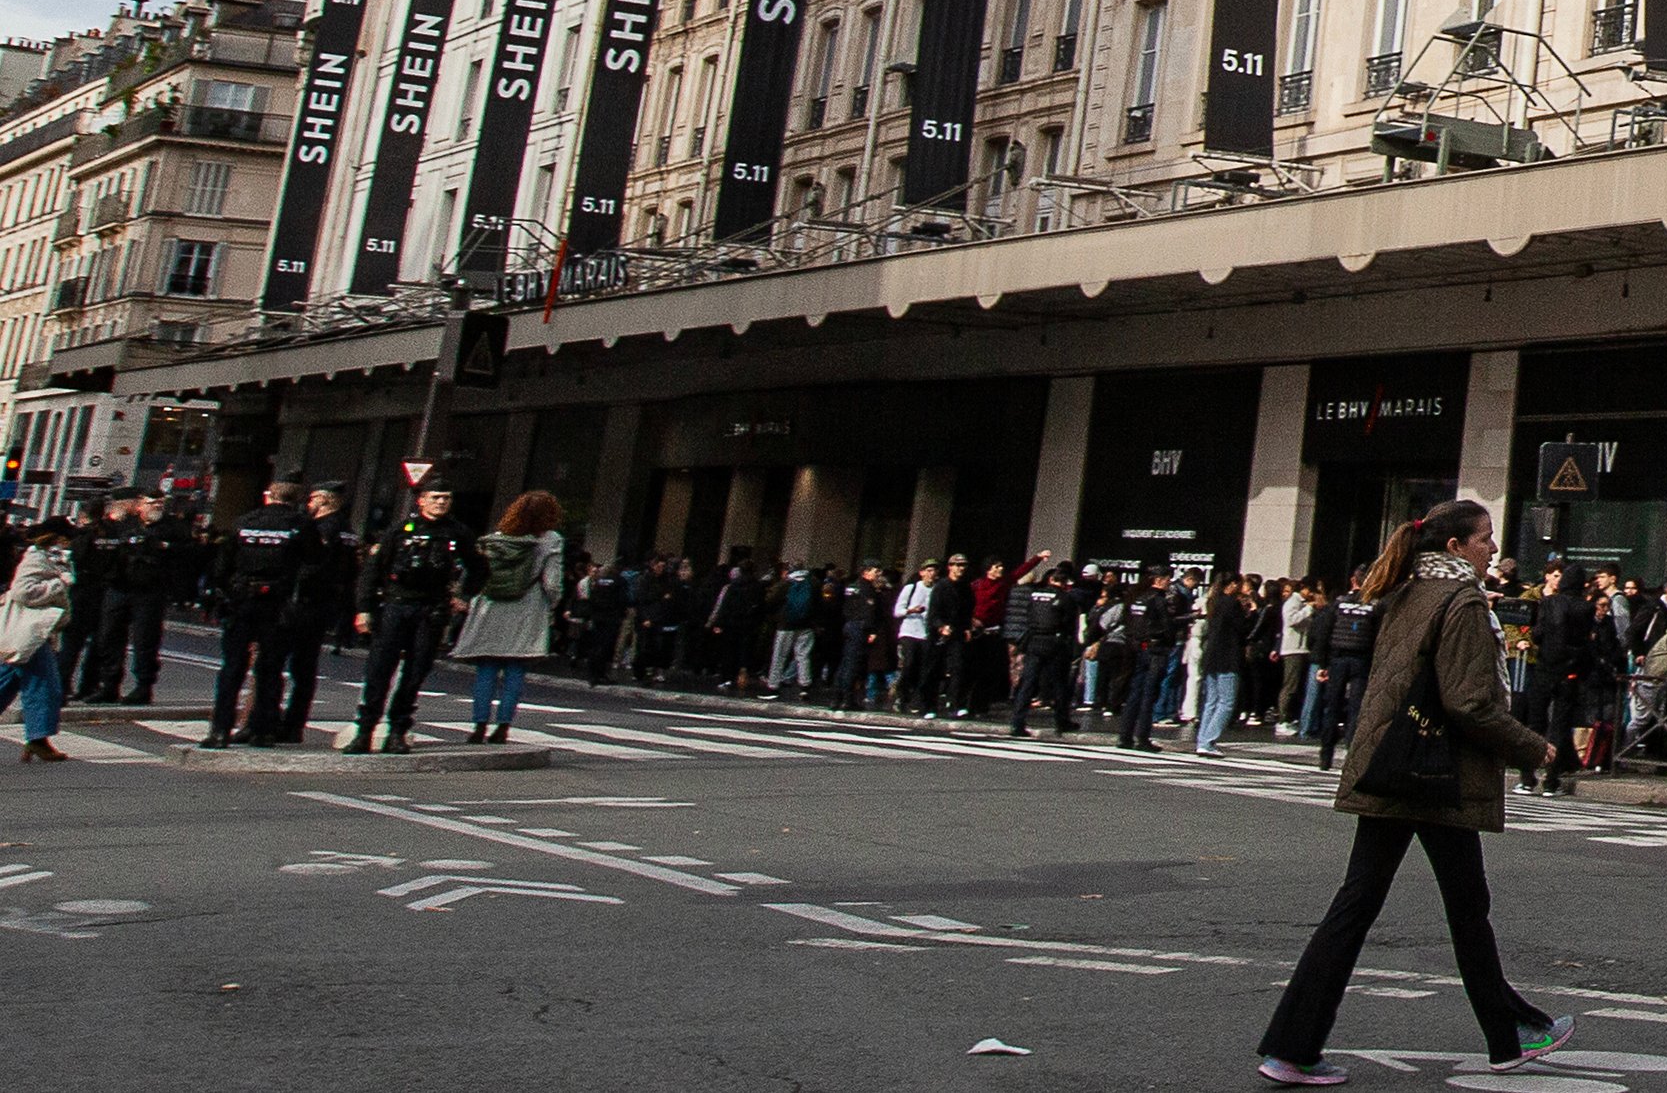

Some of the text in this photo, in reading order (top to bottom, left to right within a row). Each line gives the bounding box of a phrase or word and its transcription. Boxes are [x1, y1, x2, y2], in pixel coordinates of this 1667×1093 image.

[1223, 49, 1263, 76] 5.11
[391, 14, 443, 134] SHEIN
[299, 53, 347, 164] SHEIN
[923, 120, 961, 141] 5.11
[734, 163, 768, 182] 5.11
[582, 197, 614, 214] 5.11
[366, 238, 395, 253] 5.11
[277, 260, 305, 273] 5.11
[1317, 397, 1442, 419] LE BHV MARAIS
[1152, 450, 1182, 475] BHV
